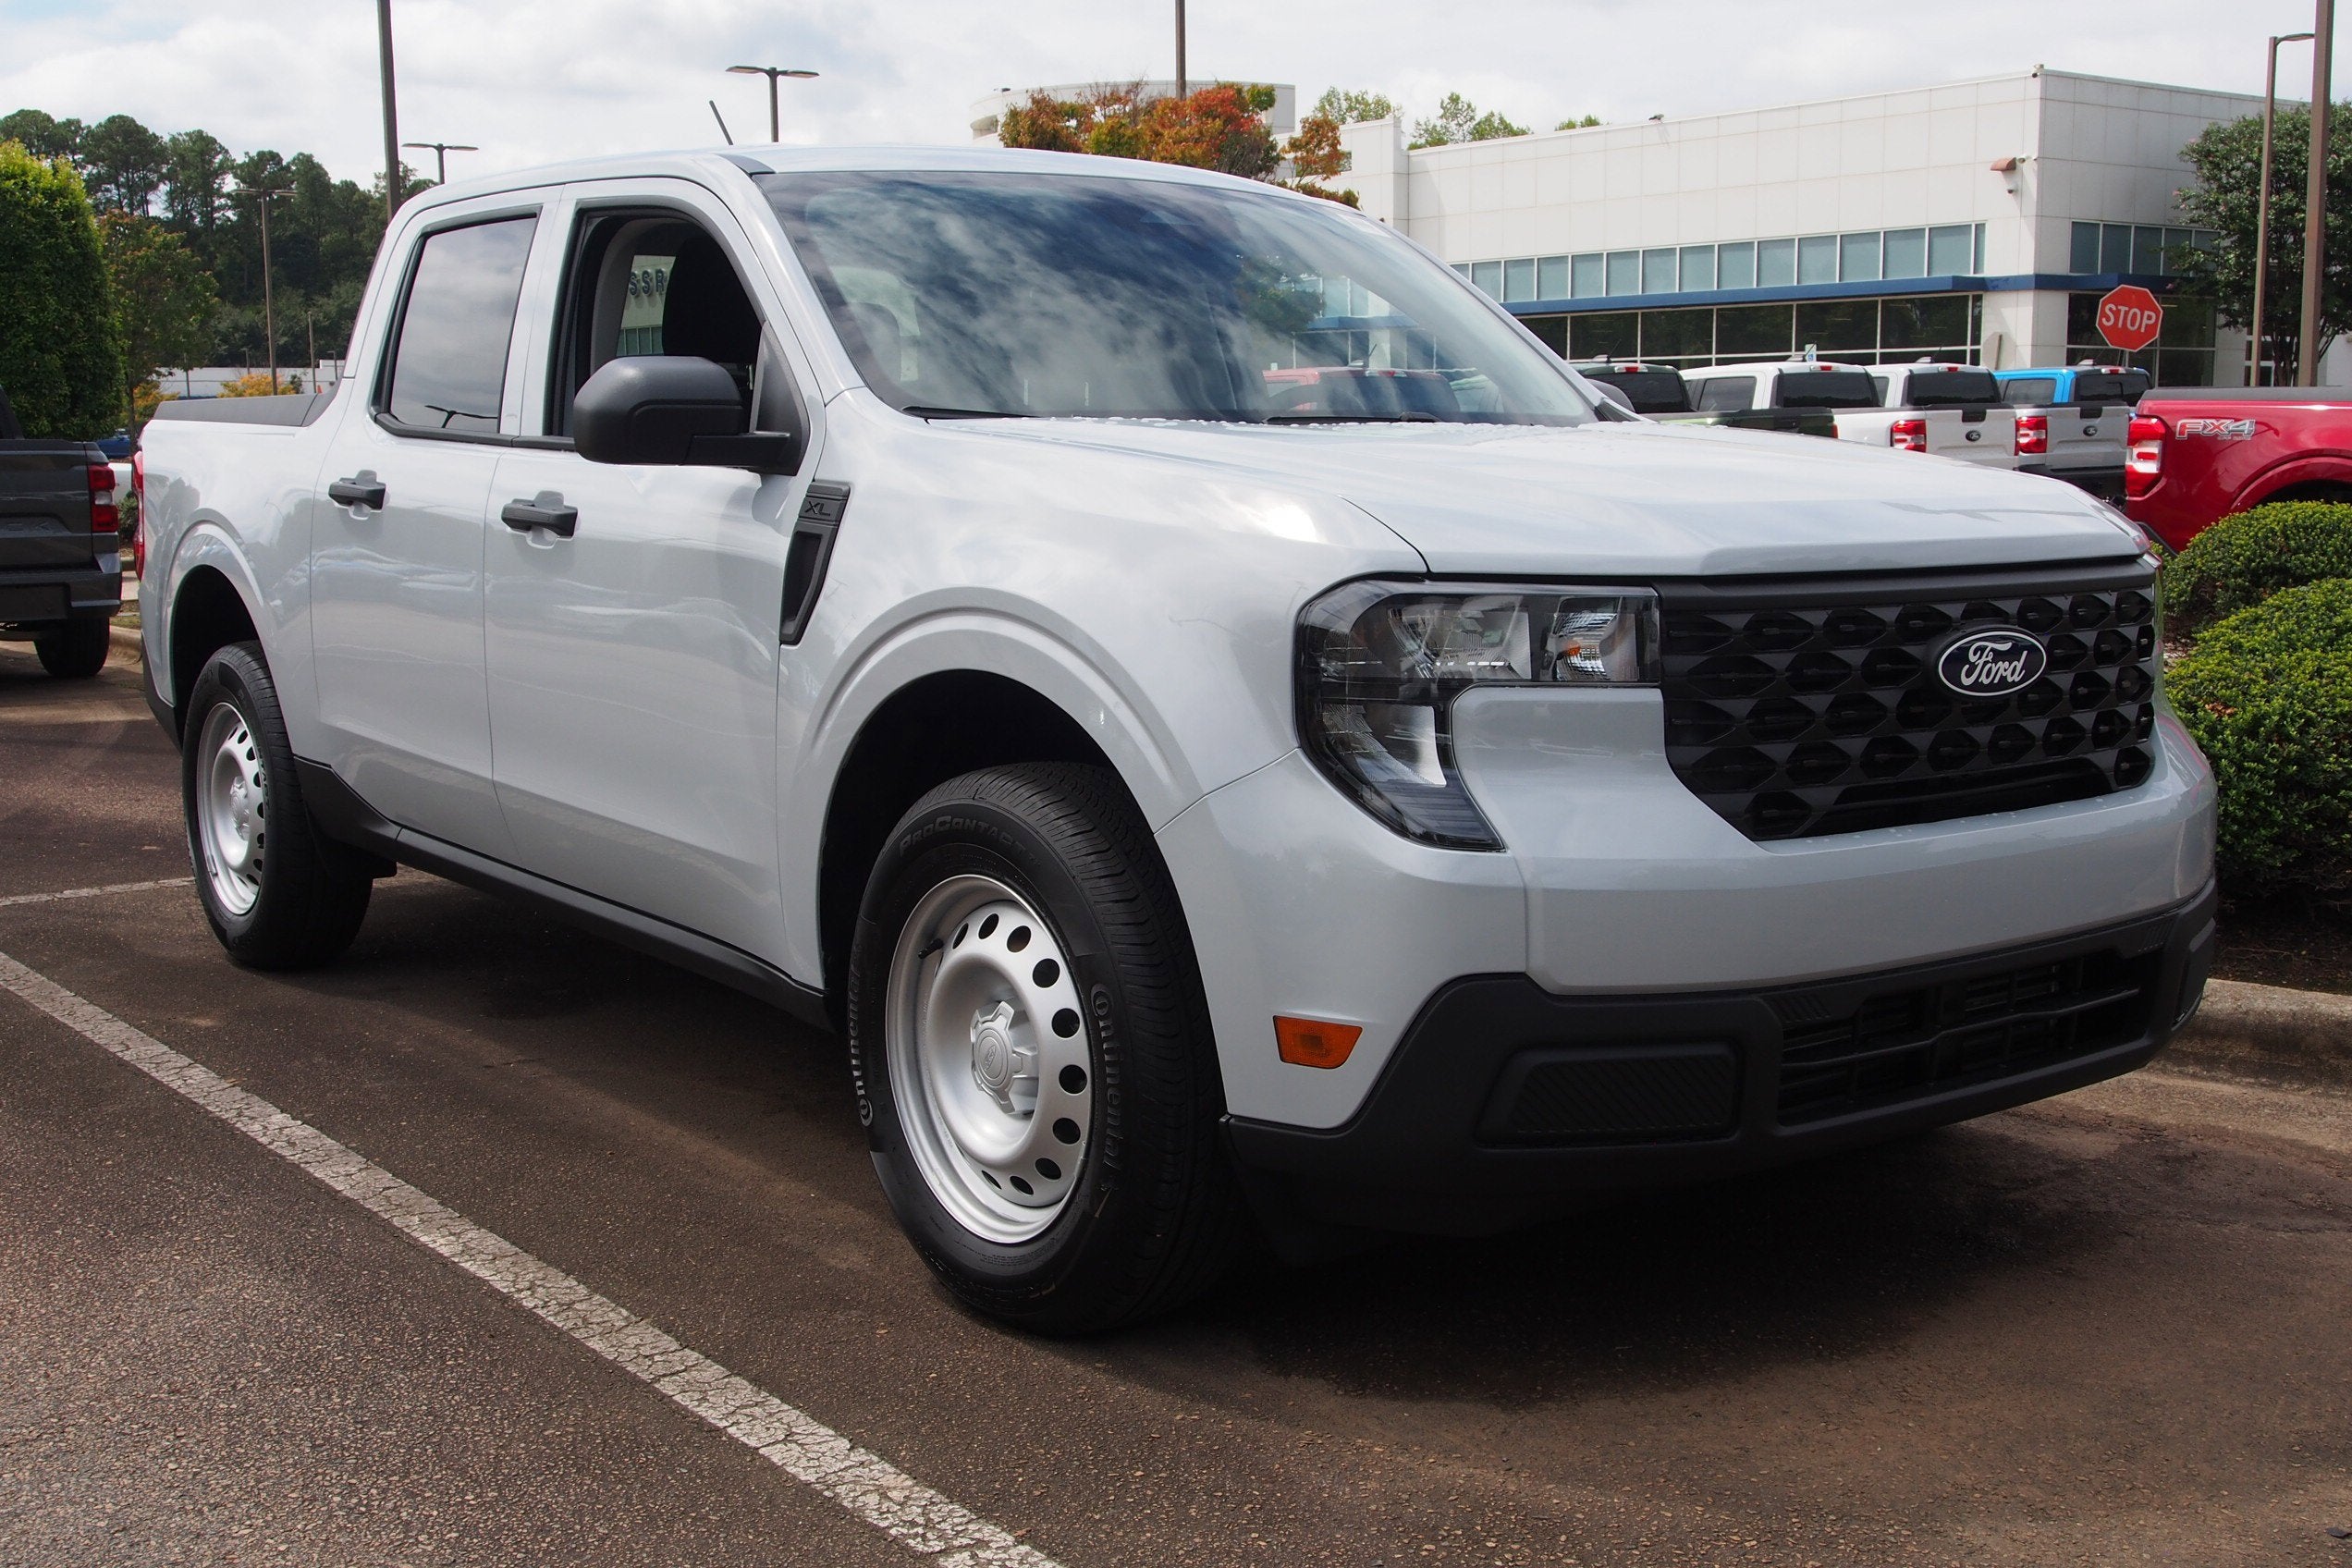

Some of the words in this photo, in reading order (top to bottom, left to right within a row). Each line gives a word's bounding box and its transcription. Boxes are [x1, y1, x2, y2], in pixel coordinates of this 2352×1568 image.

[2101, 303, 2156, 333] STOP
[2175, 418, 2256, 440] FX4
[805, 501, 831, 516] XL
[1960, 641, 2028, 686] Ford
